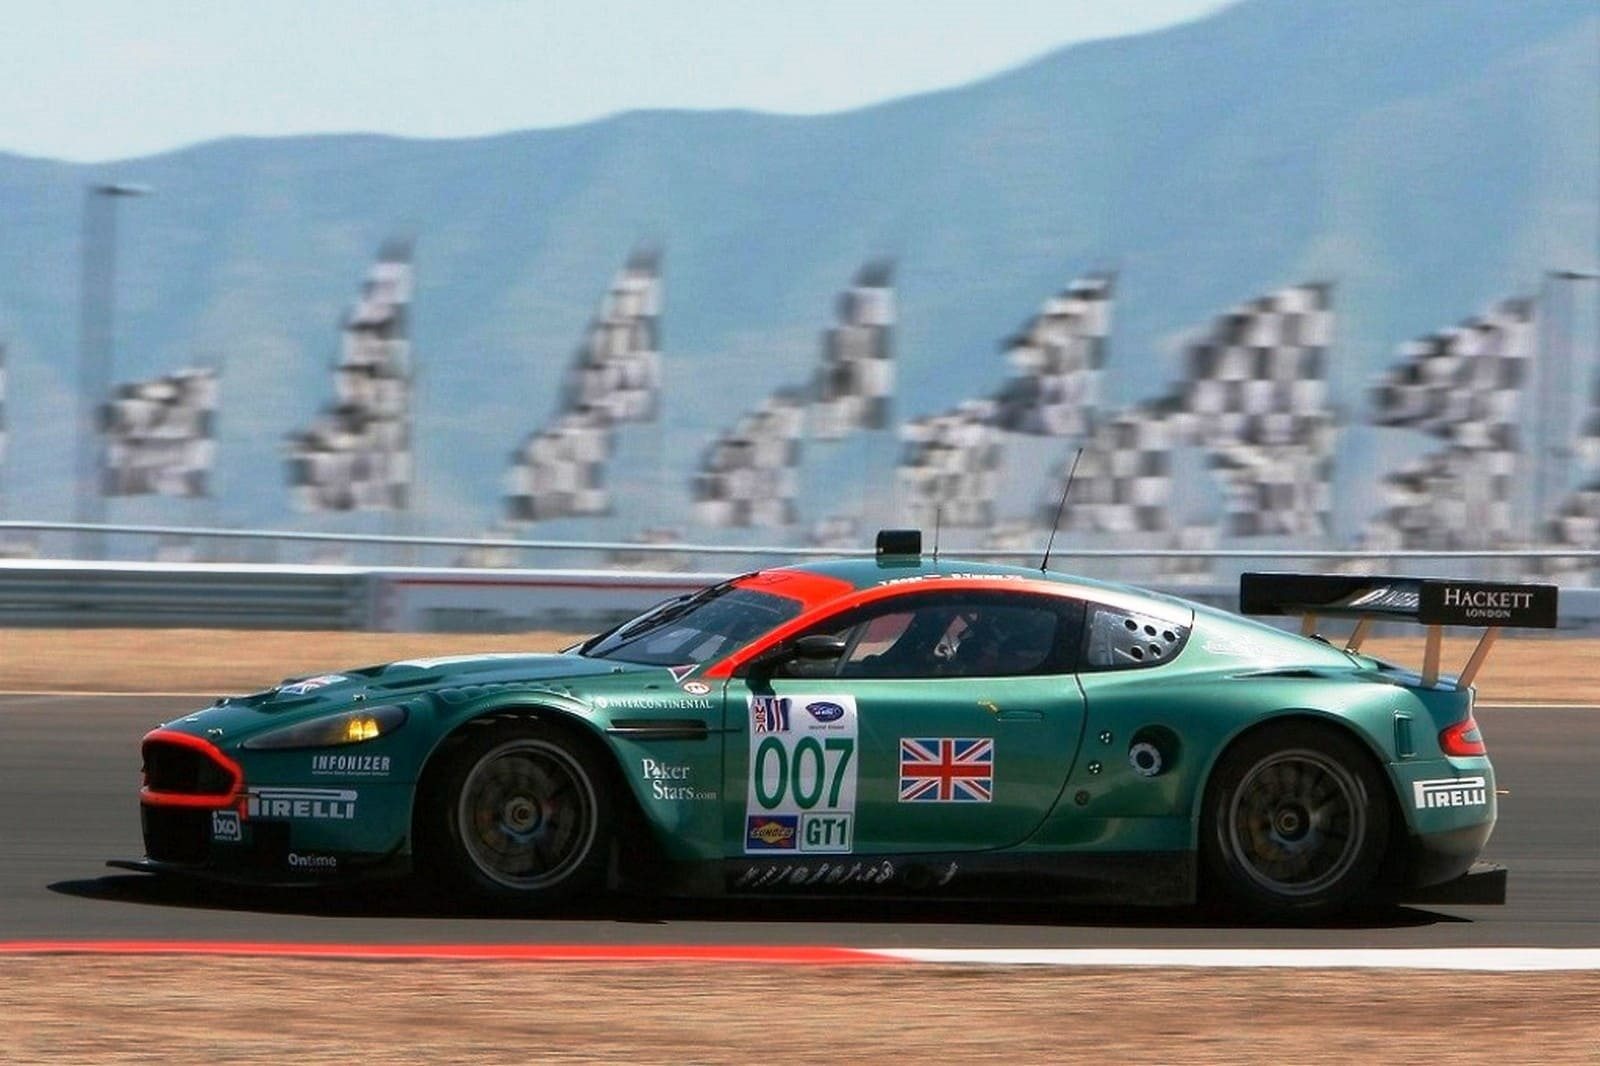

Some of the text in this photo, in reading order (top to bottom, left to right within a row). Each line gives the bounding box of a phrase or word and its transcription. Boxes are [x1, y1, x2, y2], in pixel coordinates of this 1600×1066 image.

[1444, 588, 1533, 609] HACKETT
[1466, 608, 1511, 619] LONDON
[311, 755, 391, 770] INFONIZER
[754, 736, 854, 810] 007
[248, 787, 357, 819] PIRELLI
[1413, 777, 1486, 808] PIRELLI
[752, 828, 793, 840] SUNOCO
[806, 819, 848, 846] GT1
